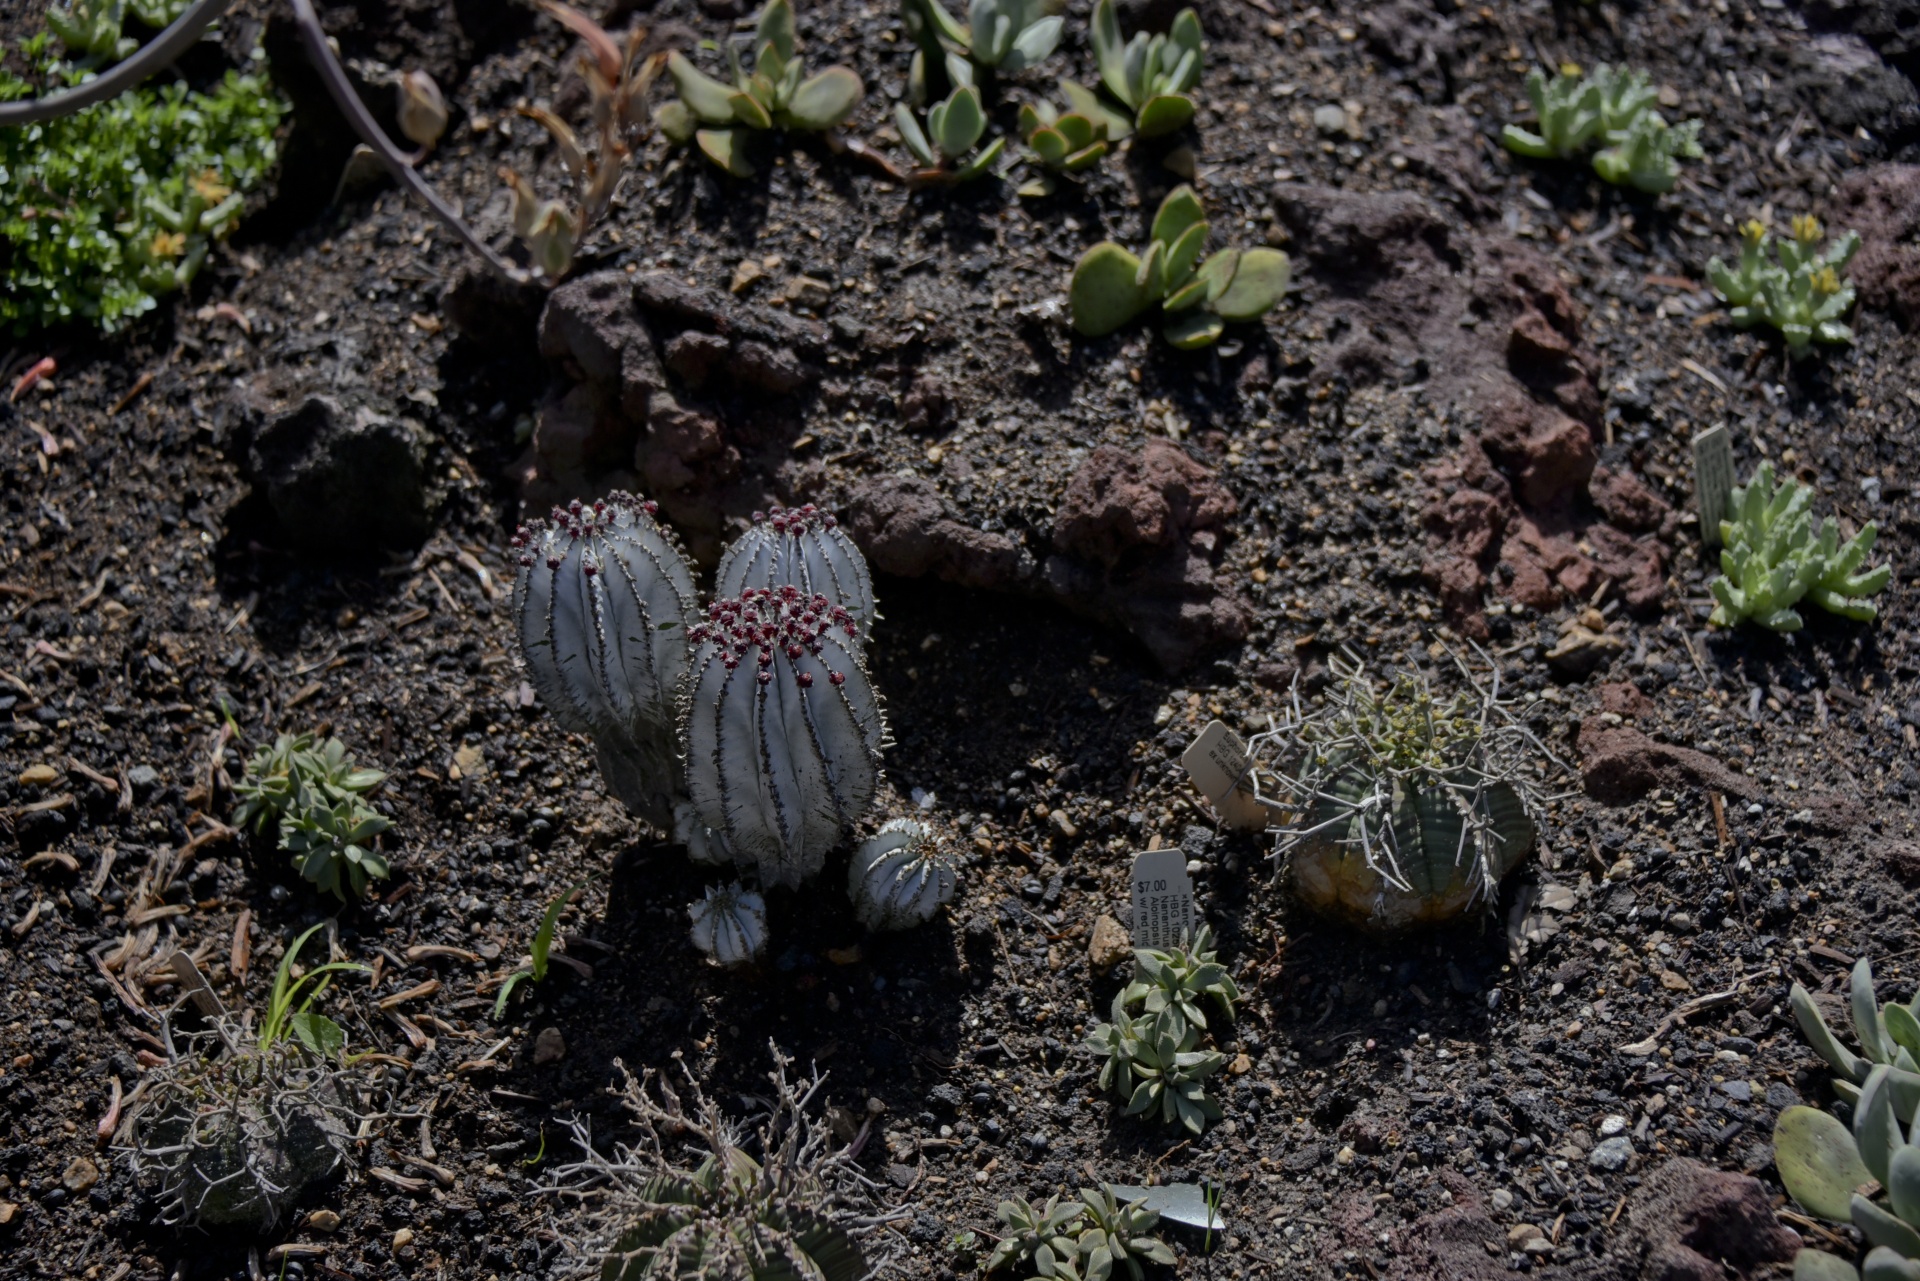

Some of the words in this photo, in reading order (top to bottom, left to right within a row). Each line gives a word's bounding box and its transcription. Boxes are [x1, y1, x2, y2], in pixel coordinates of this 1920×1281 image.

[1137, 879, 1167, 894] $7.00
[1139, 897, 1149, 909] w/
[1170, 894, 1180, 918] HBG
[1140, 911, 1150, 927] red
[1150, 896, 1160, 946] Aloinopsis
[1160, 895, 1170, 948] Nananthus
